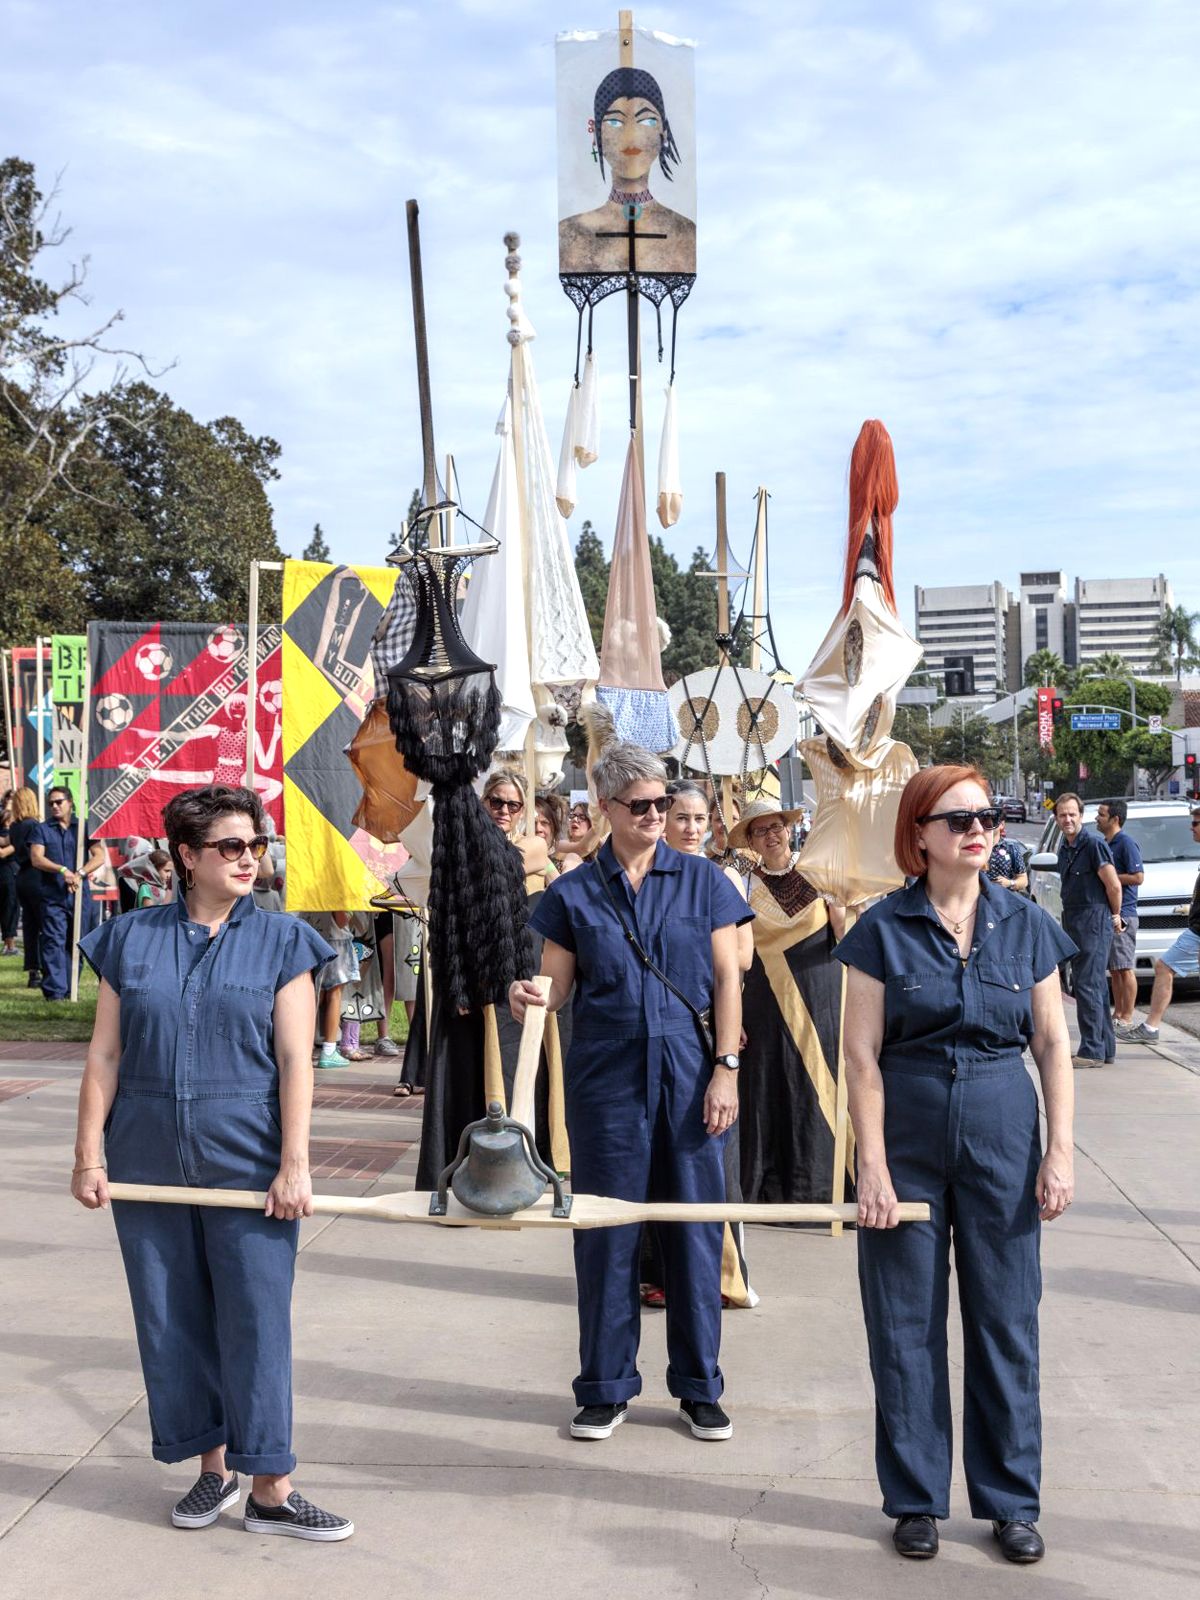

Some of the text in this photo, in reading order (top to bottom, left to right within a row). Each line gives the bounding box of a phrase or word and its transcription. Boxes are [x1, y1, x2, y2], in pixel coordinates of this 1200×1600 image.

[112, 772, 141, 800] NOT
[145, 738, 176, 769] LET
[182, 700, 213, 731] THE
[254, 629, 282, 658] WIN
